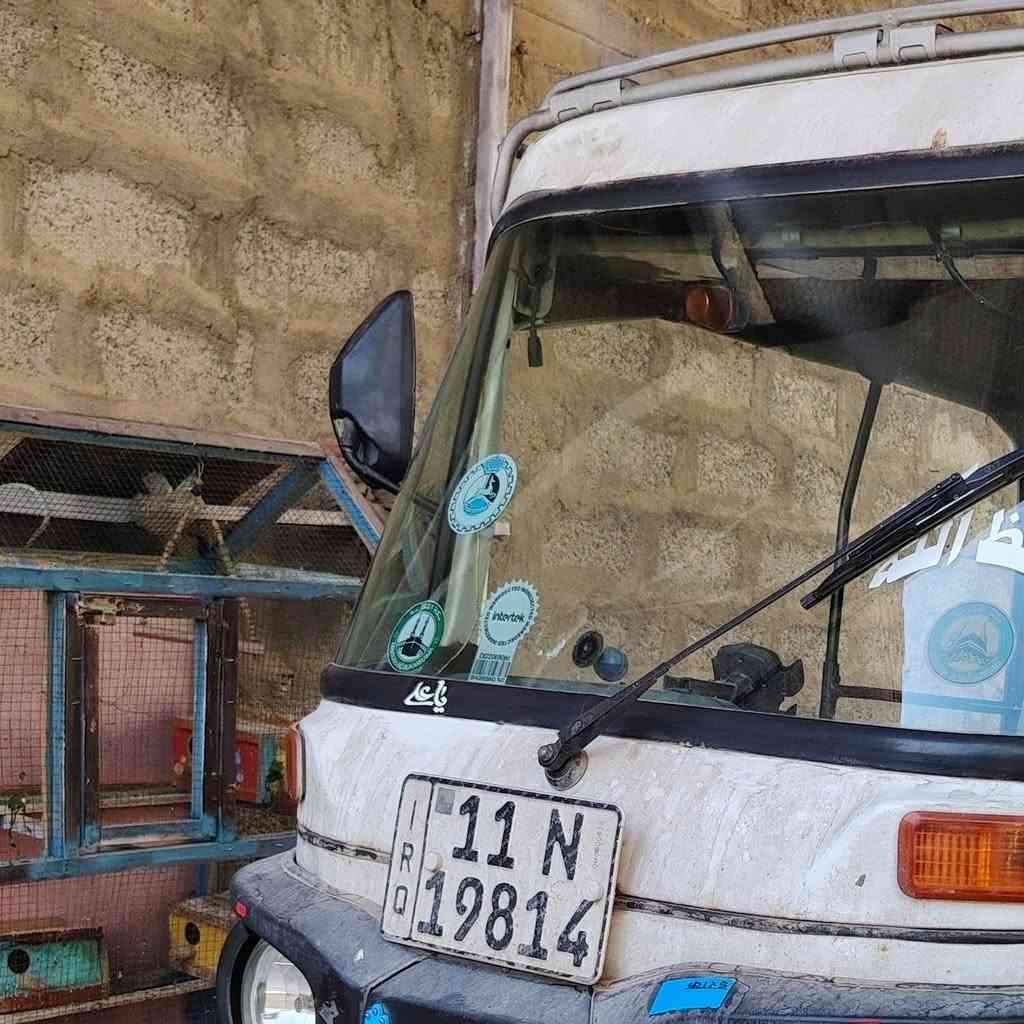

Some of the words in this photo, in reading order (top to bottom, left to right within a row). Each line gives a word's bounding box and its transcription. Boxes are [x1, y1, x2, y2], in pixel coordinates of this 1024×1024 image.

[452, 794, 516, 869] 11
[542, 808, 584, 881] N
[416, 870, 589, 968] 19814
